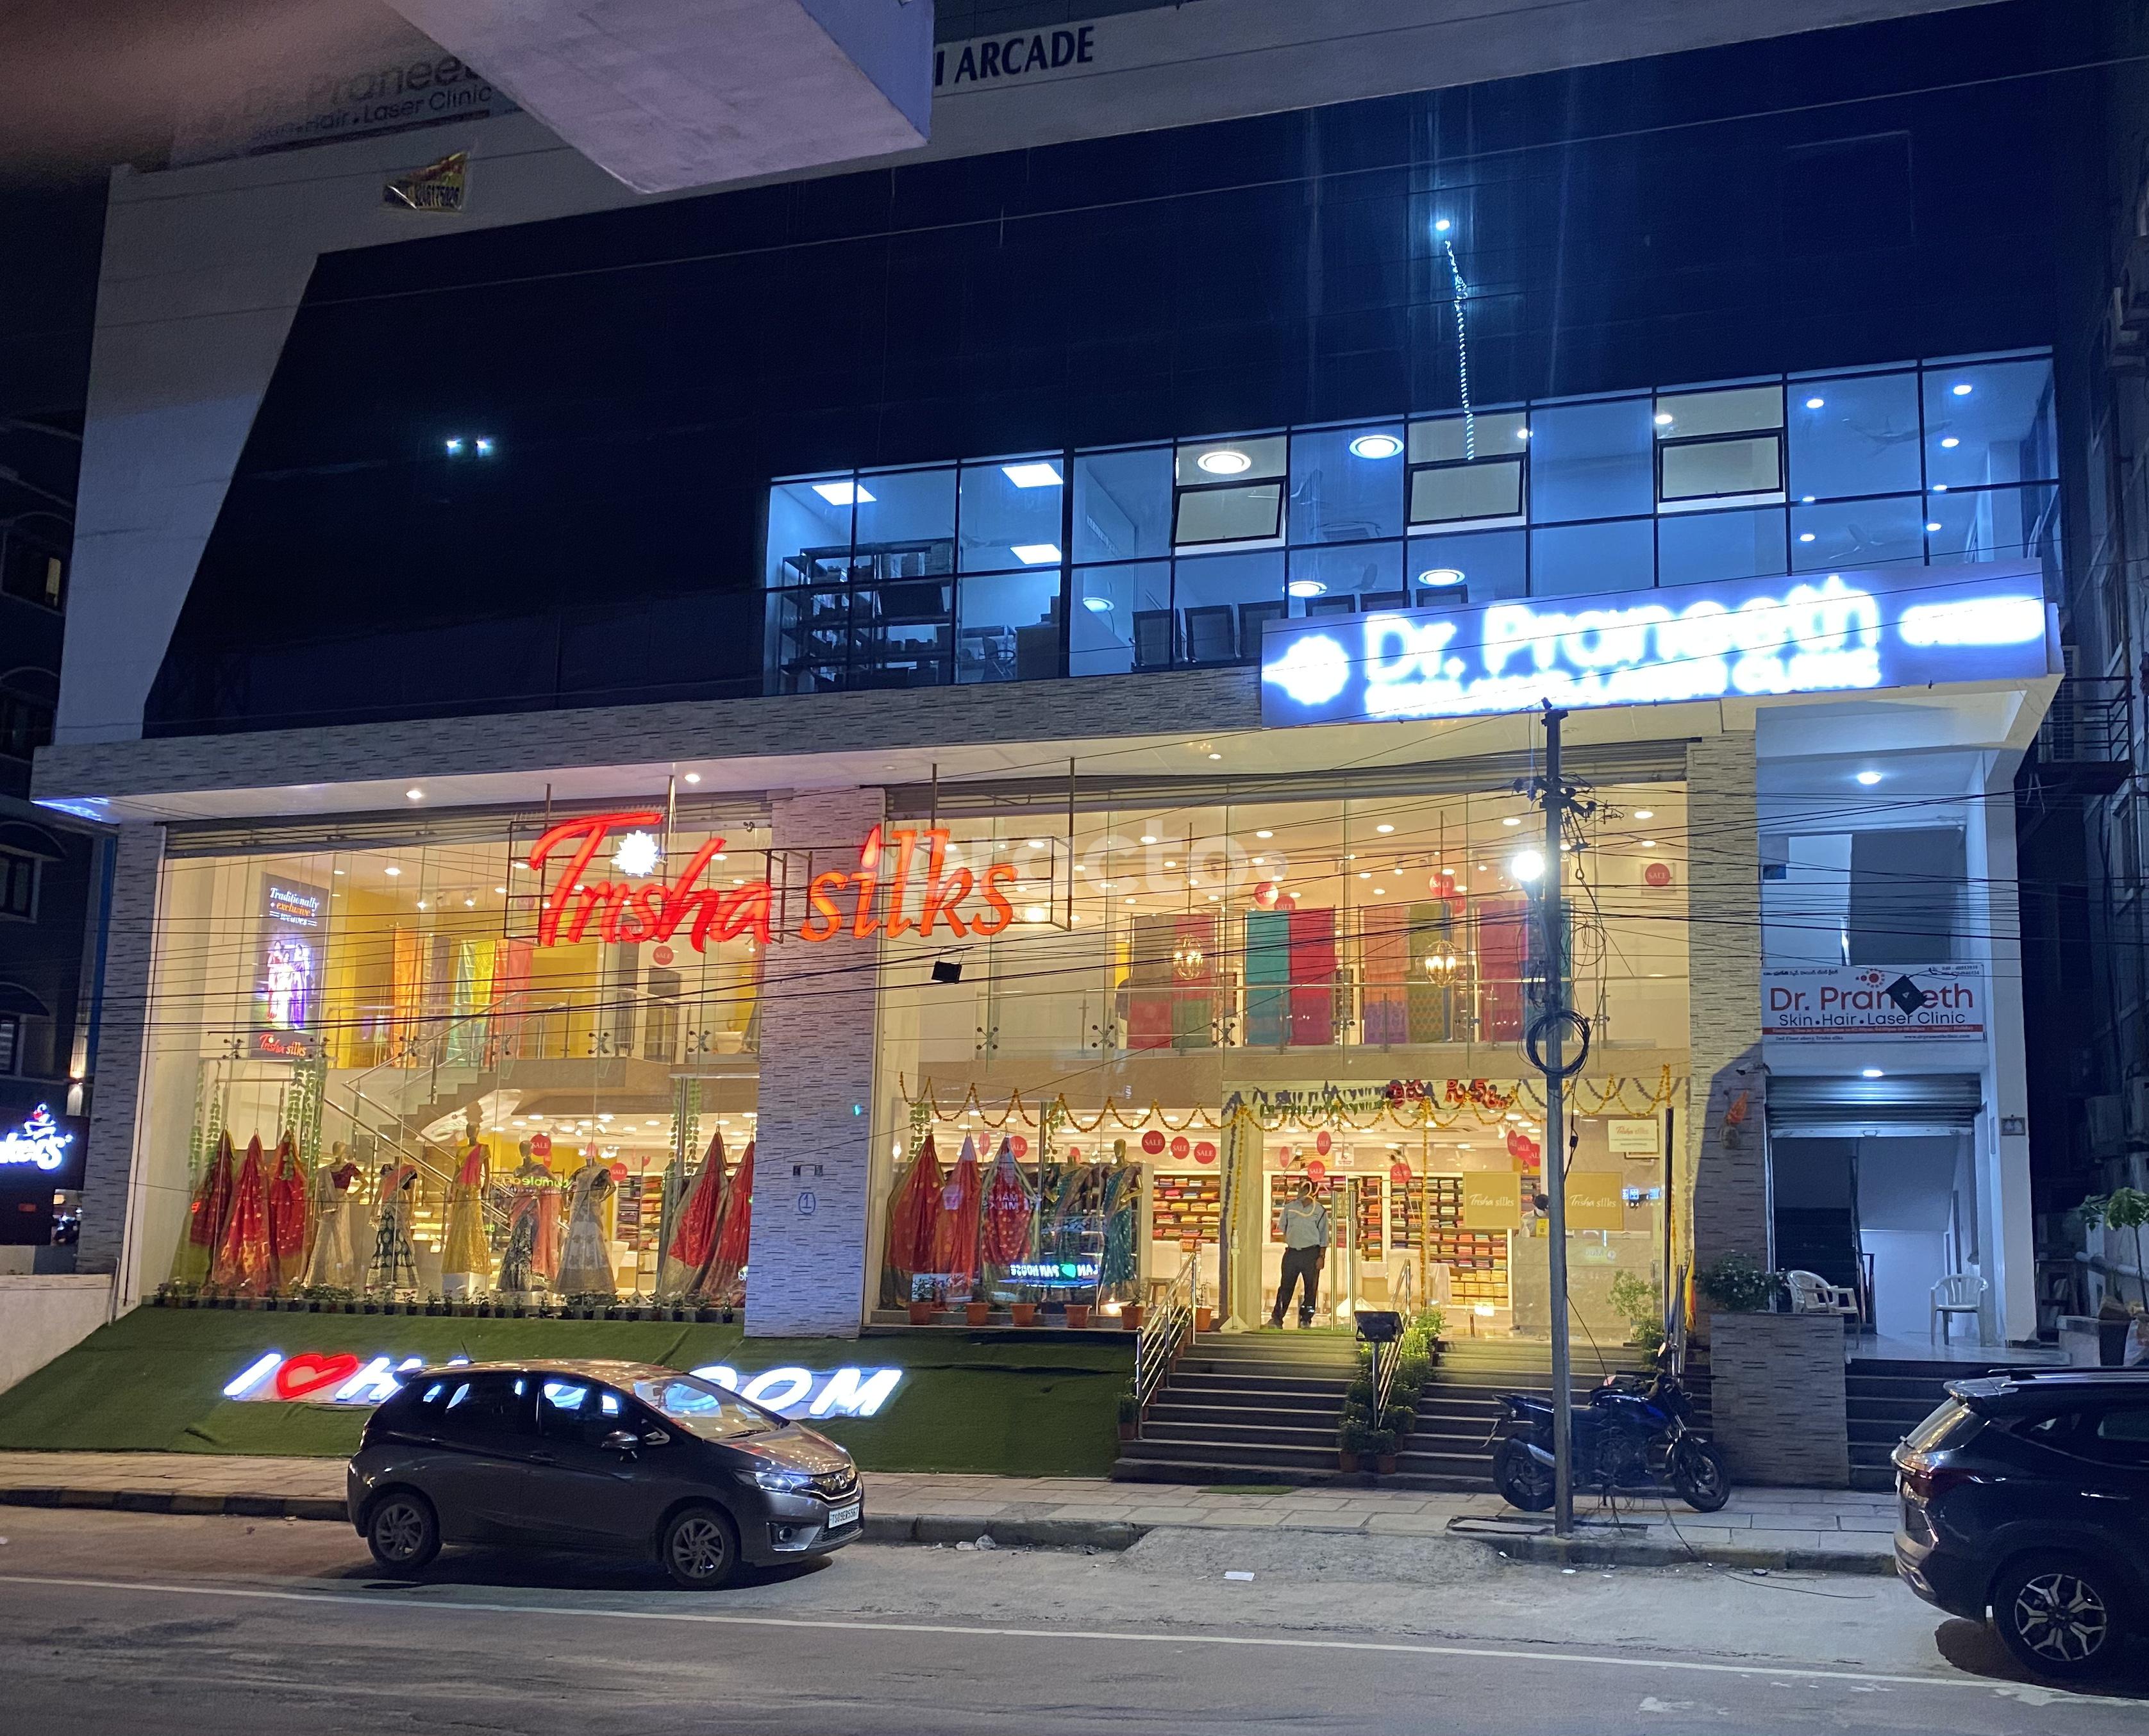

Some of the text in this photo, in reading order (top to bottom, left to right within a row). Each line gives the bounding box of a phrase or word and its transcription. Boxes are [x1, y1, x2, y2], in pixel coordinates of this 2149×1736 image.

[954, 26, 1094, 83] ARCADE
[364, 99, 424, 123] Laser
[429, 85, 492, 111] Clinic
[1364, 614, 1465, 683] Dr.
[529, 812, 1018, 953] Trisha silks
[270, 887, 319, 912] Traditionally
[1770, 983, 1973, 1011] Dr. Praneth
[1779, 1011, 1966, 1026] Skin Hair Laser Clinic
[1469, 1194, 1514, 1206] Trisha silks
[1569, 1194, 1616, 1208] Trisha silks
[224, 1353, 281, 1396] I
